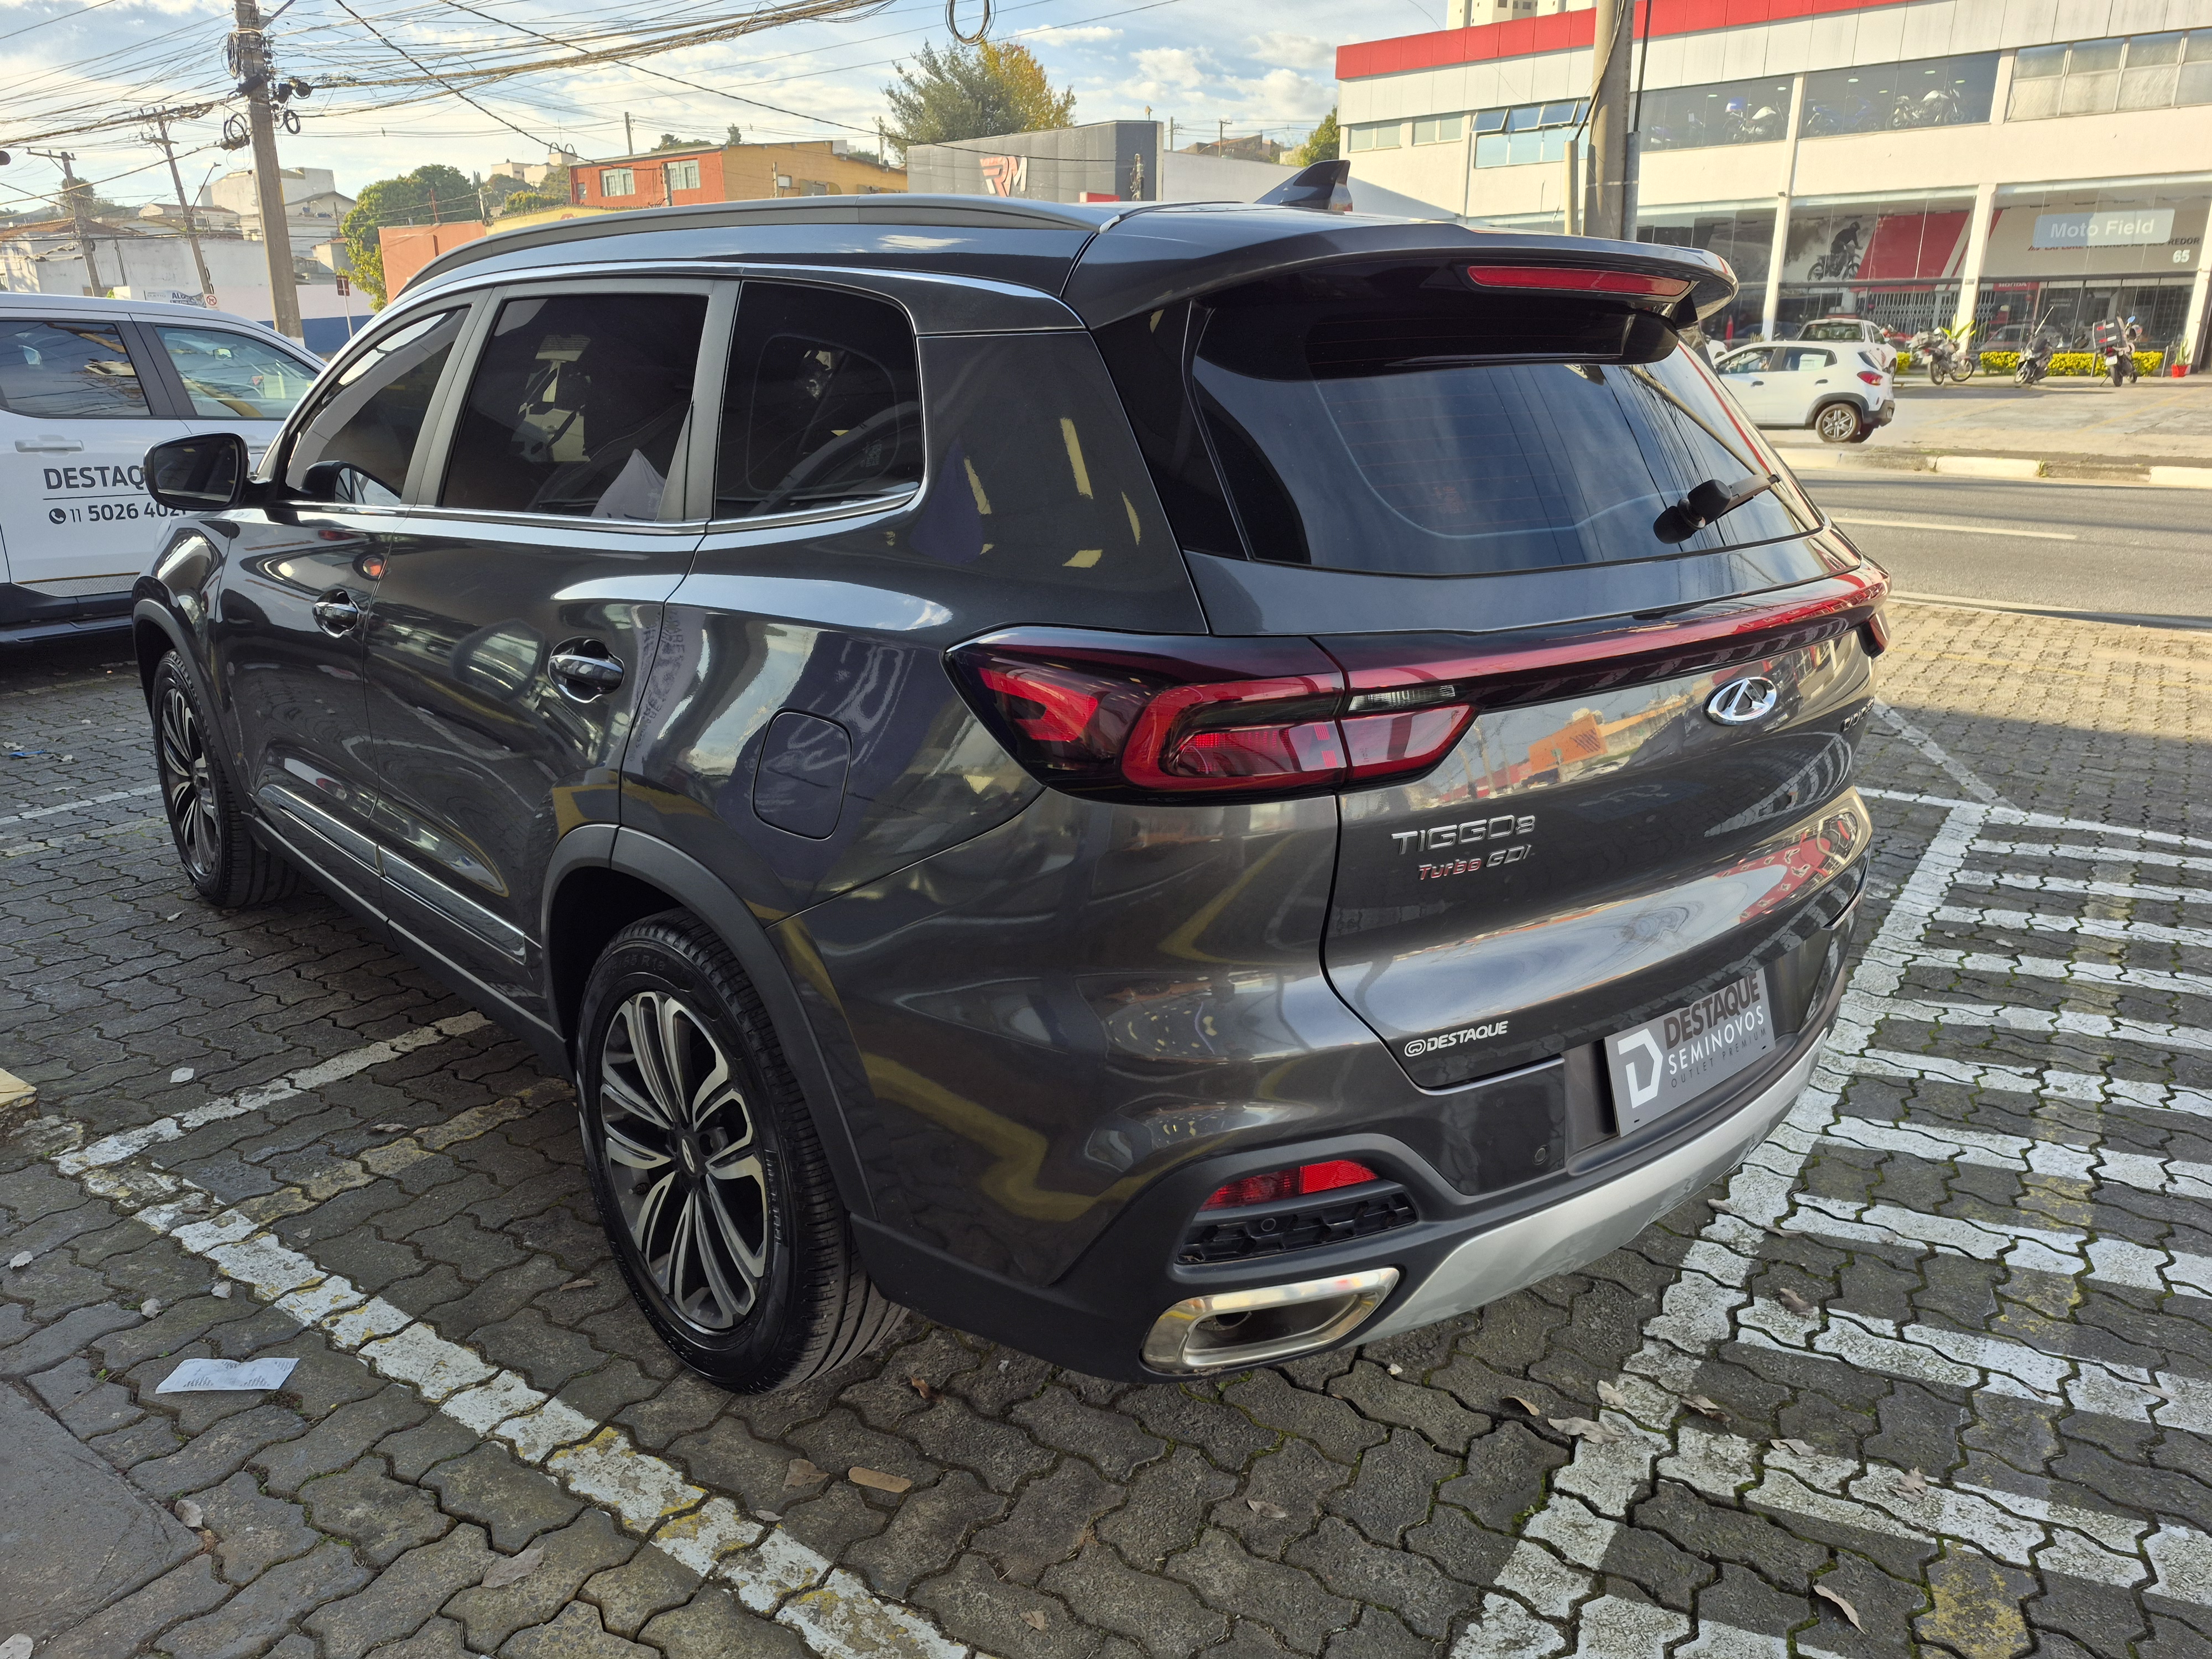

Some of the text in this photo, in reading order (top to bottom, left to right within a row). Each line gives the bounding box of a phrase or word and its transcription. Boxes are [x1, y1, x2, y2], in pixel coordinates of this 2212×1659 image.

[2051, 219, 2154, 238] Moto Field
[2168, 237, 2200, 246] REDOR
[2173, 249, 2190, 263] 65
[43, 465, 145, 490] DESTAQ
[70, 509, 81, 522] 11
[88, 503, 139, 521] 5026
[1418, 844, 1532, 880] Turbo GDI
[1663, 973, 1760, 1050] DESTAQUE
[1404, 1020, 1509, 1057] @DESTAQUE
[1668, 1005, 1764, 1075] SEMINOVOS
[1671, 1027, 1766, 1088] OUTLET PREMIUM
